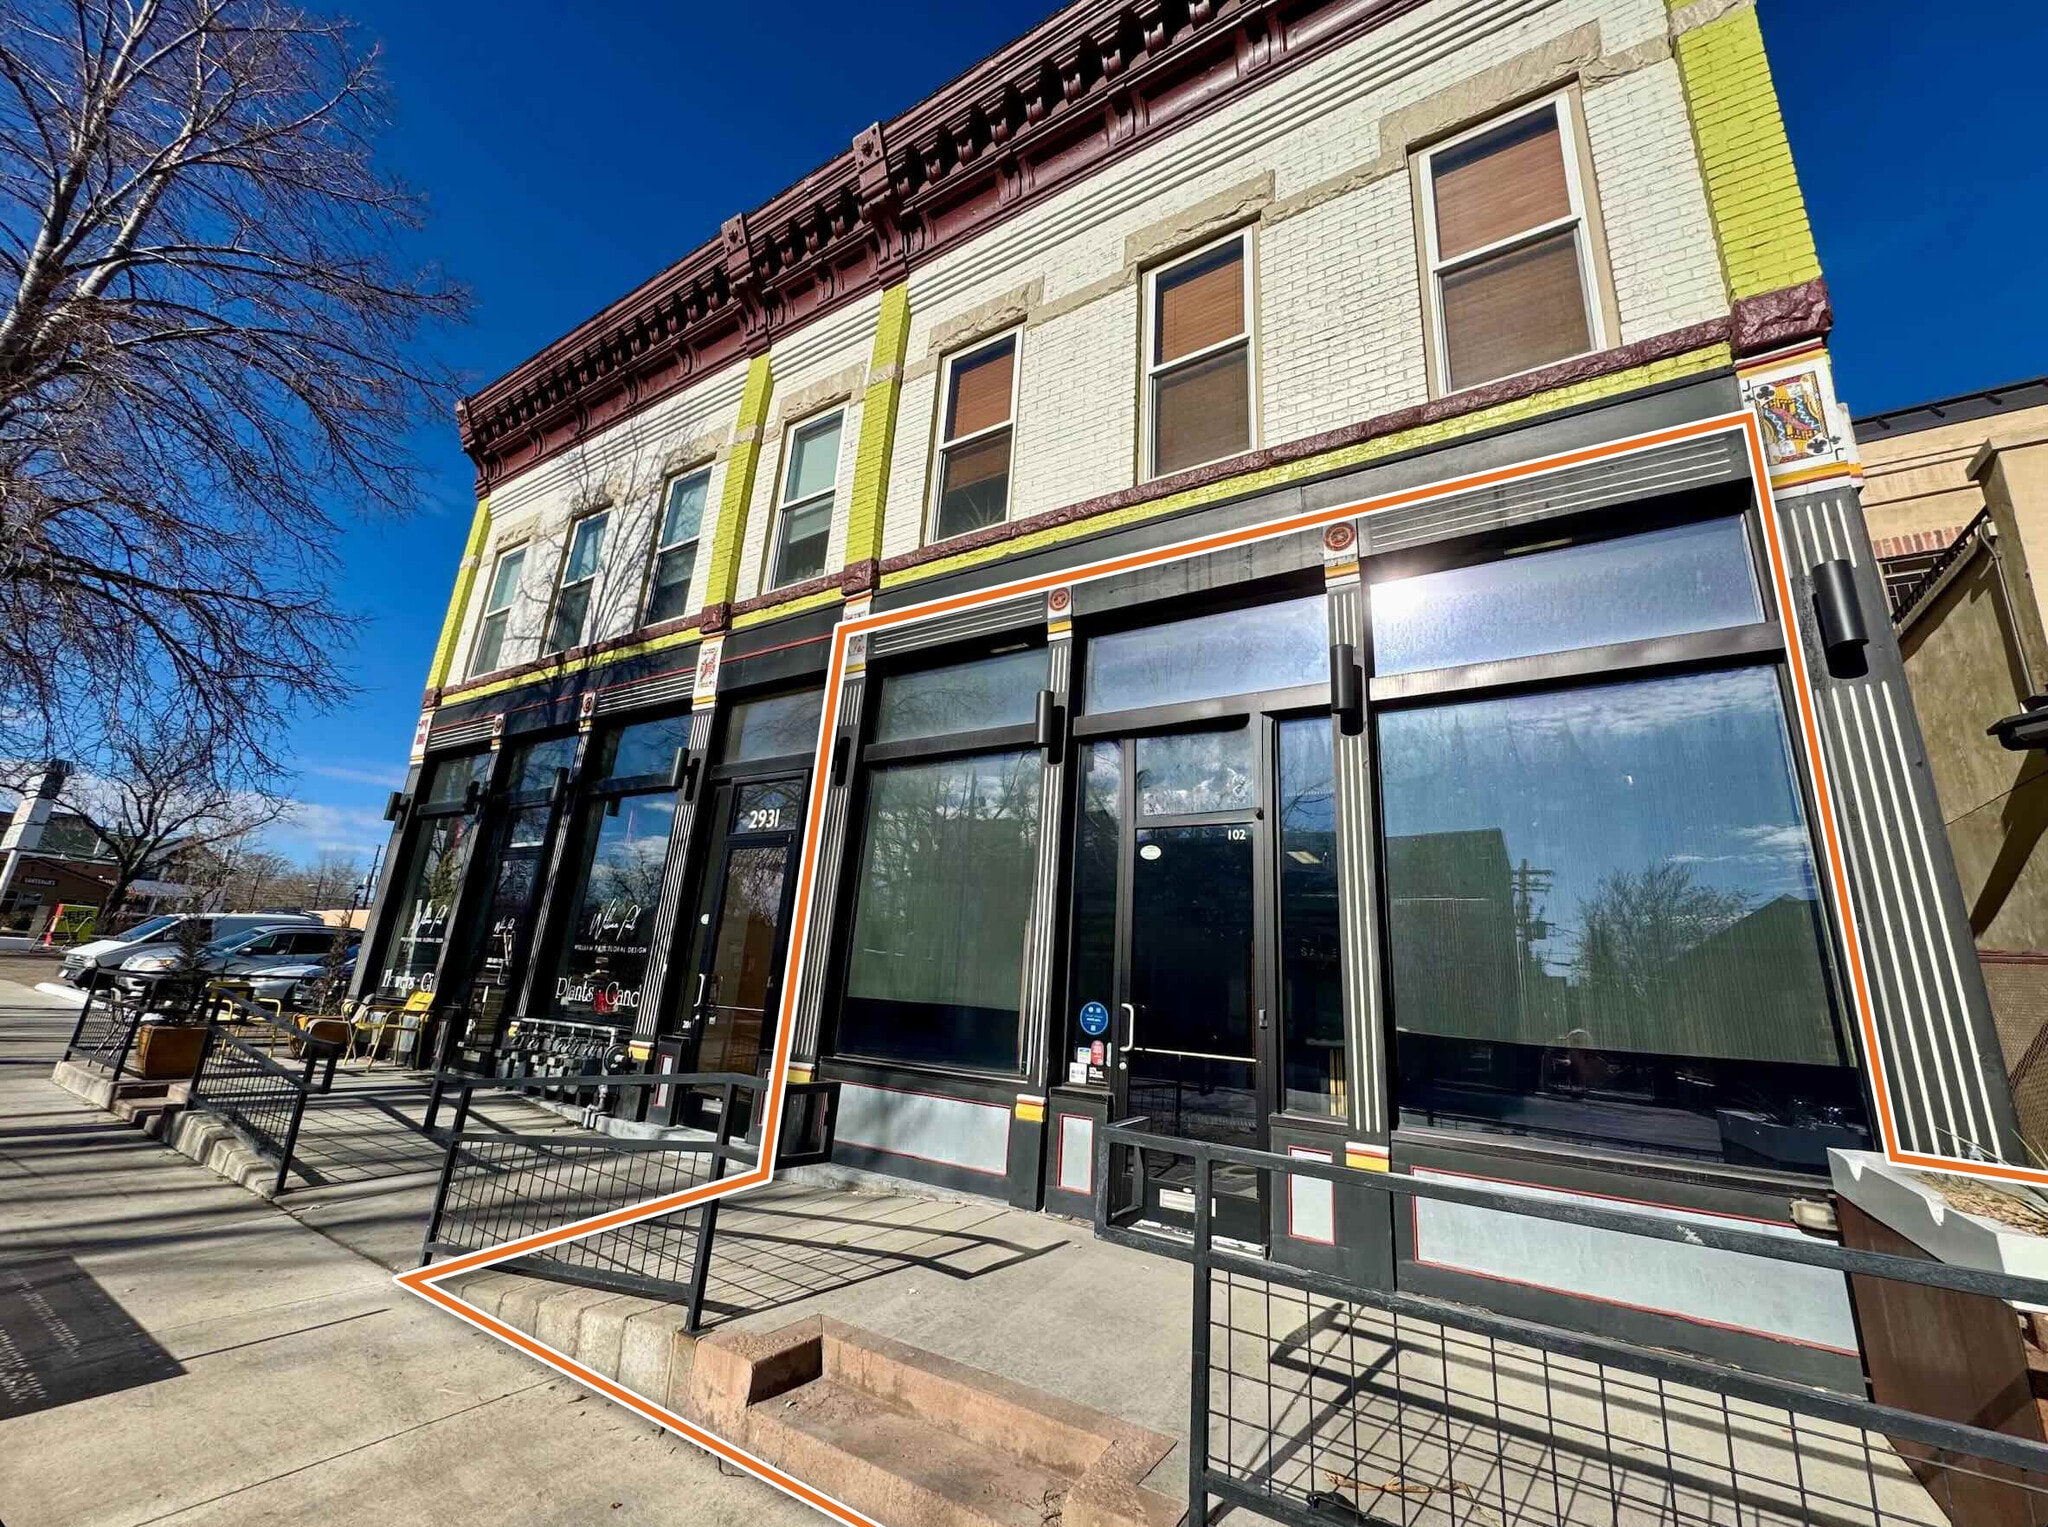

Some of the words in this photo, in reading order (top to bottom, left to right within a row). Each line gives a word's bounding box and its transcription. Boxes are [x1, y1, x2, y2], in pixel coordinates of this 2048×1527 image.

[749, 809, 780, 829] 2931
[1227, 829, 1246, 841] 102
[555, 976, 595, 1002] Plants
